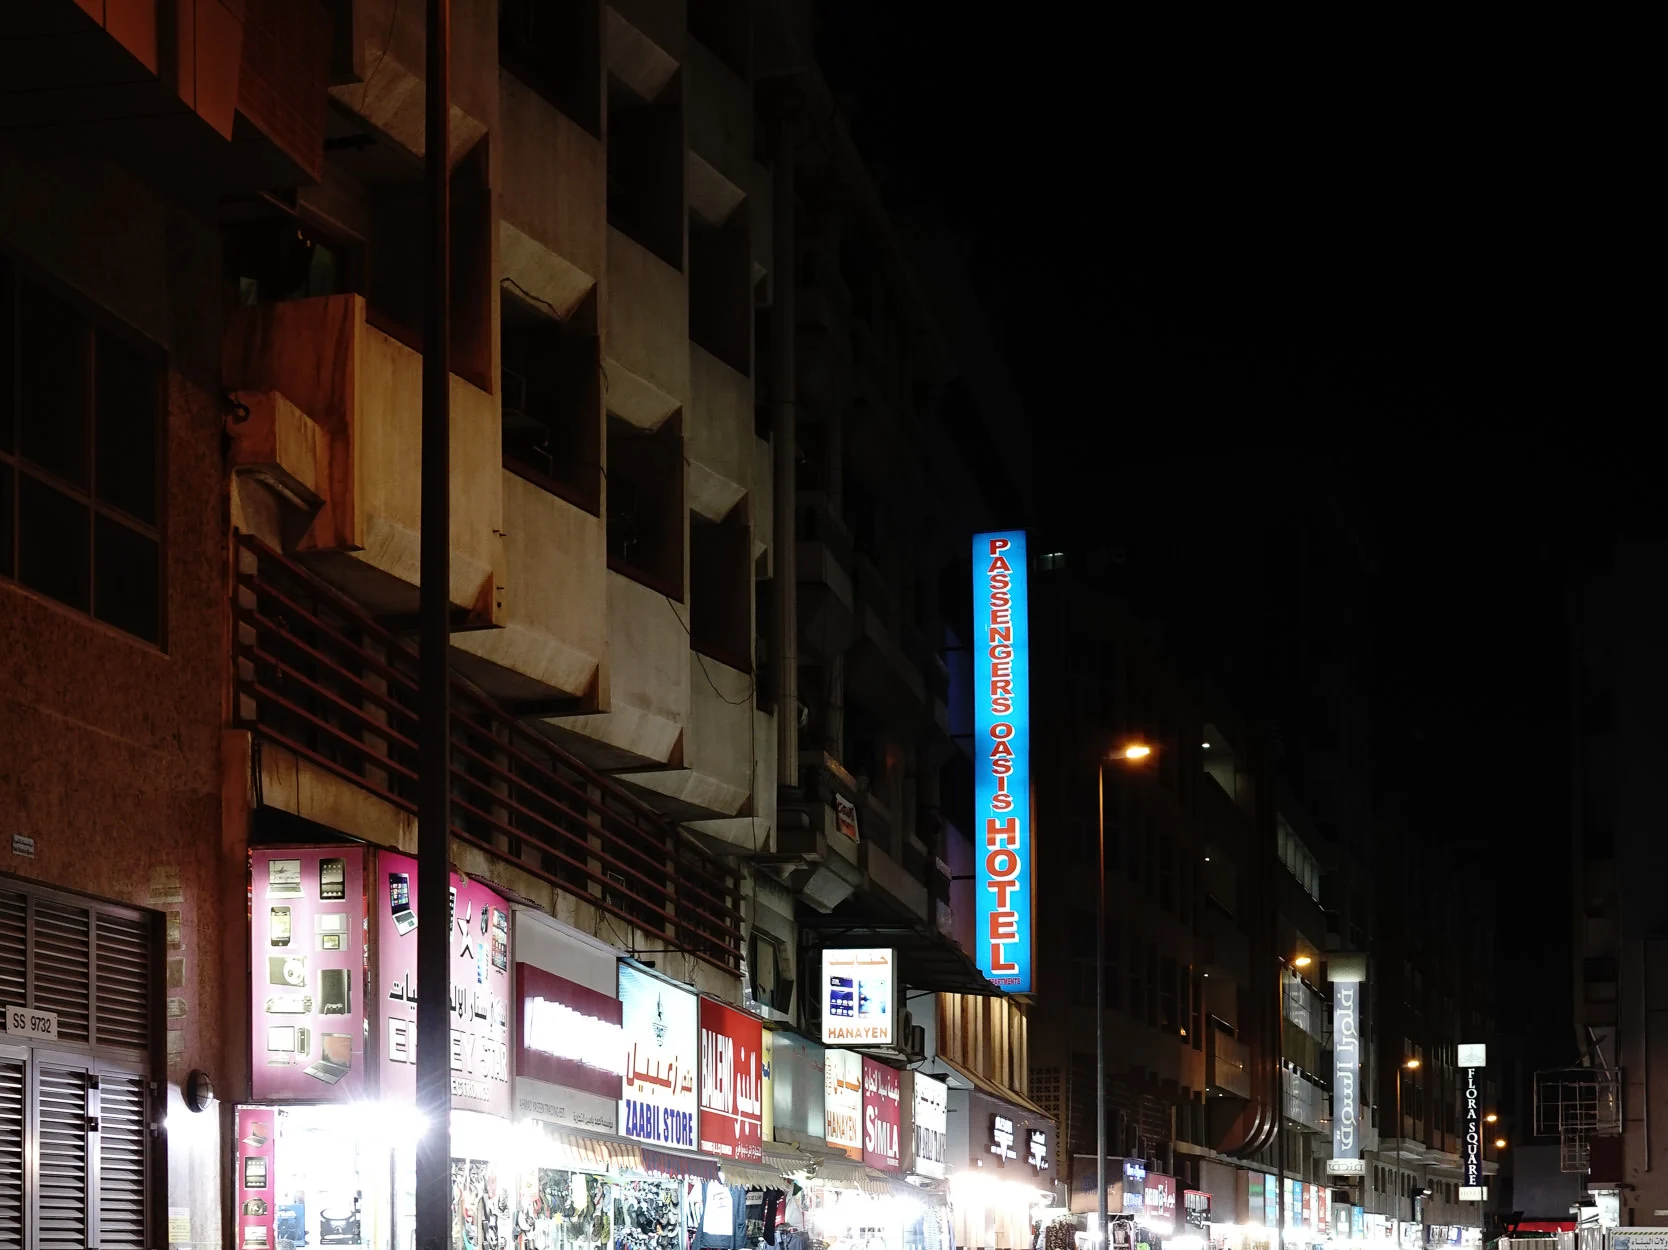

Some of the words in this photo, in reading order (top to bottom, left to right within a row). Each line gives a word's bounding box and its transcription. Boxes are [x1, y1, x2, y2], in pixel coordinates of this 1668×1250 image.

[988, 538, 1014, 715] PASSENGERS
[989, 722, 1015, 812] OASIS
[985, 817, 1021, 975] HOTEL
[989, 977, 1021, 985] PARTMENTS
[12, 1012, 26, 1030] SS
[30, 1015, 51, 1034] 9732
[828, 1027, 888, 1039] HANAYEN
[701, 1028, 734, 1114] BALENO
[1465, 1068, 1478, 1119] FLORA
[626, 1098, 661, 1141] ZAABIL
[663, 1107, 693, 1147] STORE
[826, 1109, 857, 1141] HANAYEN
[1465, 1122, 1478, 1186] SQUARE
